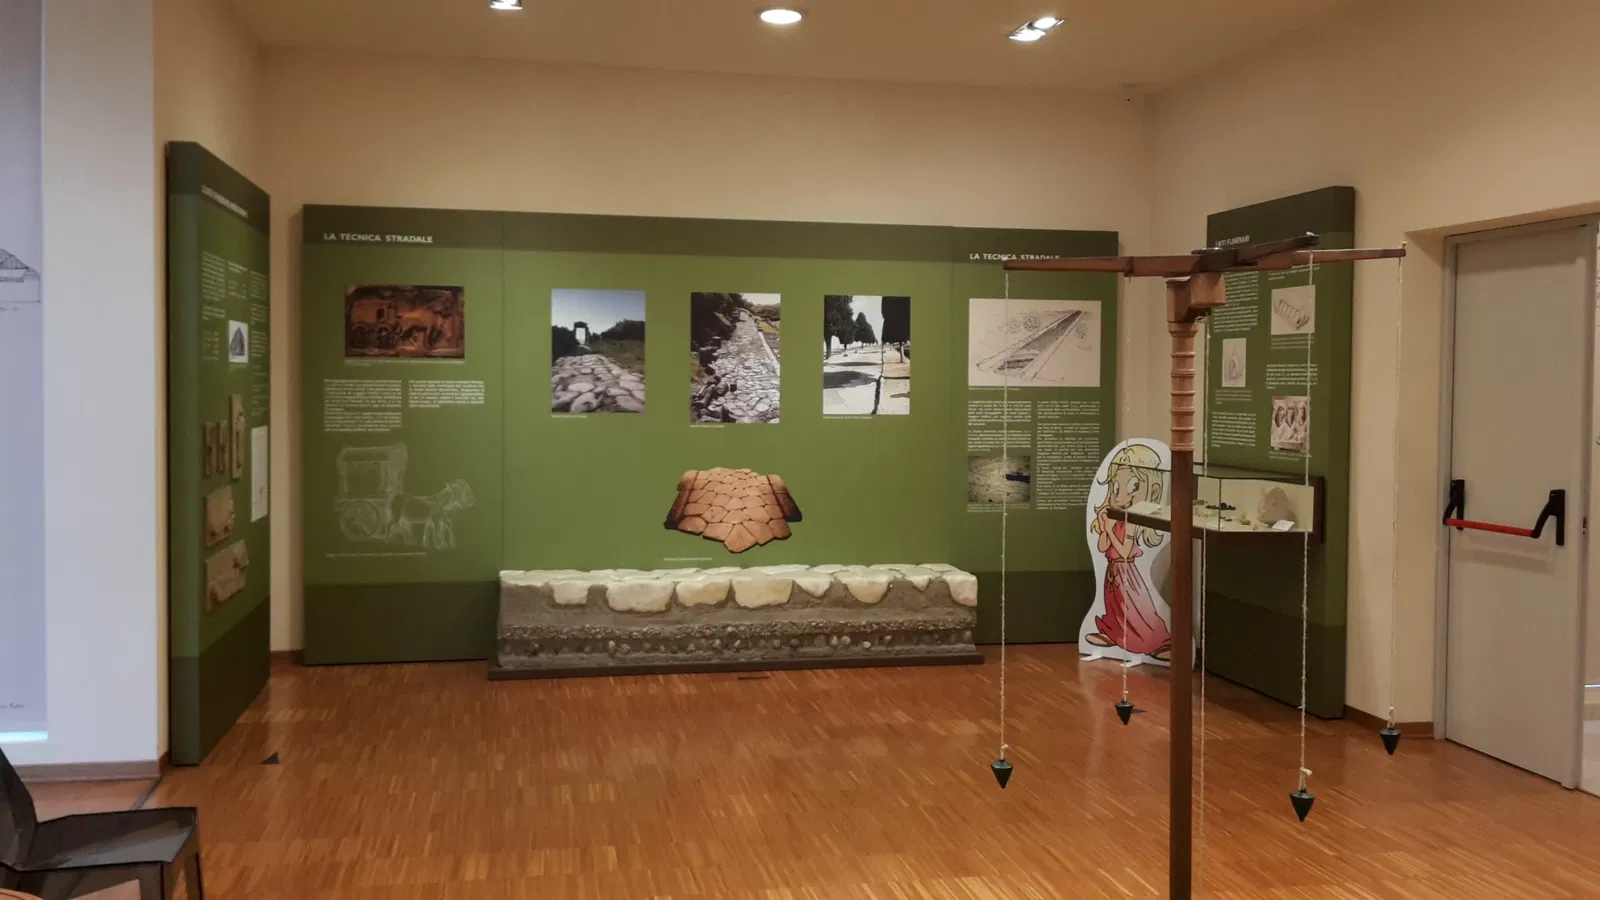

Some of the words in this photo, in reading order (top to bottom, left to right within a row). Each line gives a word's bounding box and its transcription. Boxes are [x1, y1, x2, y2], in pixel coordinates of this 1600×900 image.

[323, 233, 336, 241] LA
[340, 233, 381, 242] TECNICA
[385, 234, 433, 243] STRADALE
